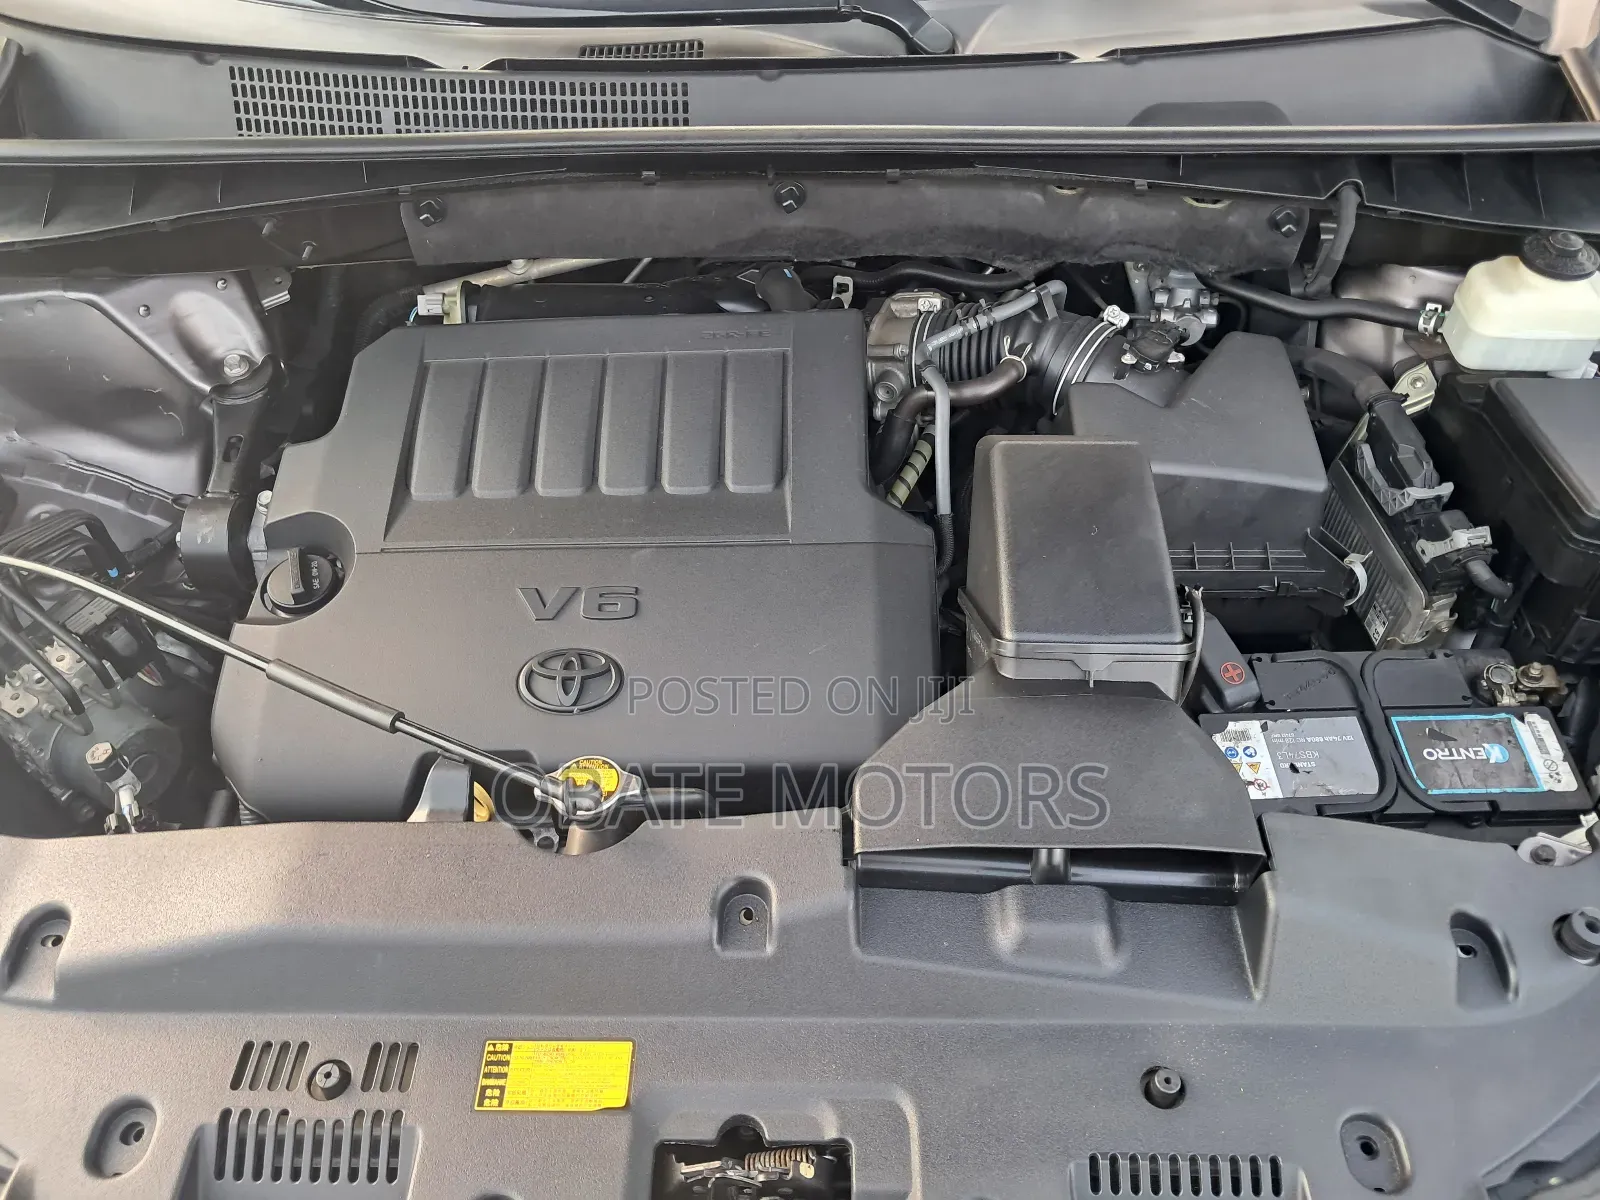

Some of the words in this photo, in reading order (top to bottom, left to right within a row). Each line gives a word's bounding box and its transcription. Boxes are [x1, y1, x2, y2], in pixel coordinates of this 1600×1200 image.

[517, 584, 642, 622] V6
[1276, 750, 1319, 760] KBS74L3
[1423, 743, 1506, 764] KENTRO
[1279, 761, 1316, 769] STANRD
[486, 1053, 511, 1062] CAUTION
[484, 1065, 509, 1073] ATTENTION
